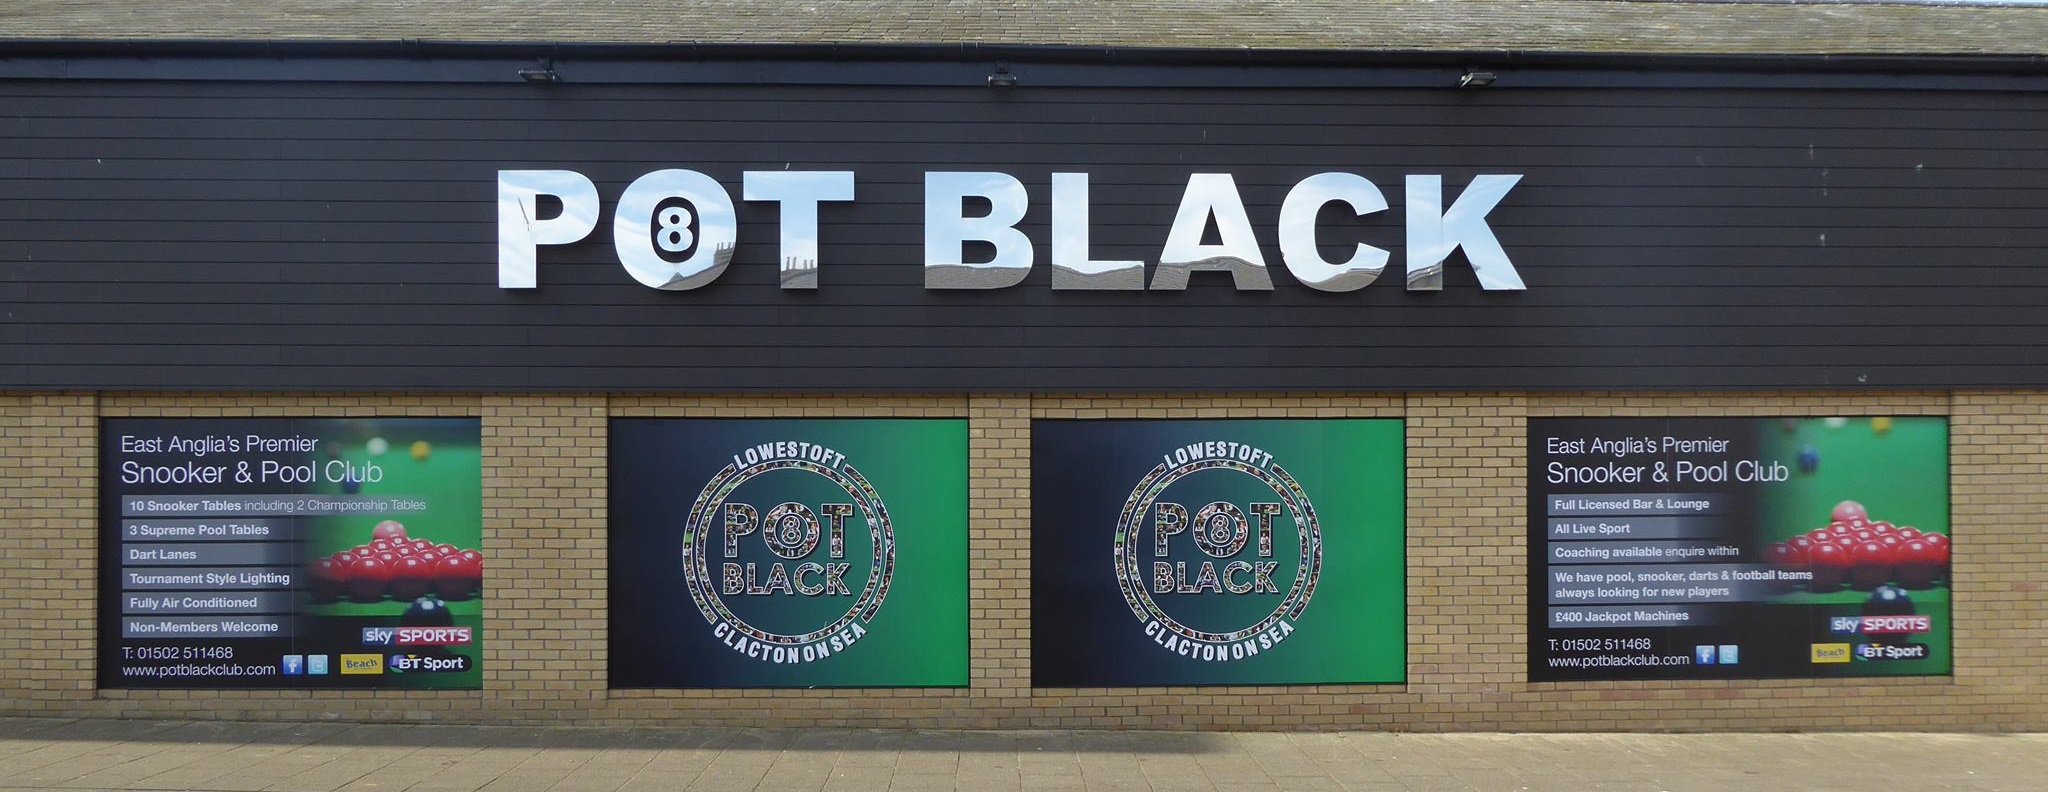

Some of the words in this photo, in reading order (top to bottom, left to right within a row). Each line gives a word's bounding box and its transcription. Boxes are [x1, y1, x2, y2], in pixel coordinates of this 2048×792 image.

[497, 169, 855, 290] POT
[924, 172, 1527, 291] BLACK
[121, 435, 163, 453] East
[246, 436, 318, 452] Premier
[1547, 438, 1585, 454] East
[1662, 437, 1729, 453] Premier
[733, 441, 846, 469] LOWESTOFT
[1164, 440, 1273, 469] LOWESTOFT
[121, 462, 227, 485] Snooker
[235, 462, 253, 483] &
[261, 461, 316, 483] Pool
[325, 460, 383, 483] Club
[1547, 463, 1645, 484] Snooker
[1652, 462, 1669, 482] &
[1676, 462, 1728, 482] Pool
[1736, 460, 1788, 482] Club
[130, 501, 144, 511] 10
[147, 501, 200, 511] Snooker
[202, 500, 241, 511] Tables
[244, 499, 294, 512] including
[297, 500, 304, 511] 2
[308, 499, 388, 512] Championship
[390, 500, 426, 510] Tables
[1555, 500, 1575, 510] Full
[1578, 499, 1630, 510] Licensed
[1634, 499, 1653, 509] Bar
[1656, 499, 1664, 509] &
[1667, 499, 1710, 512] Lounge
[130, 525, 137, 535] 3
[140, 525, 196, 538] Supreme
[199, 525, 227, 535] Pool
[229, 524, 269, 535] Tables
[724, 502, 853, 559] POT
[1155, 501, 1281, 558] POT
[1555, 524, 1568, 533] All
[1572, 524, 1595, 533] Live
[1599, 523, 1630, 536] Sport
[130, 549, 156, 560] Dart
[160, 549, 197, 560] Lanes
[1555, 547, 1609, 560] Coaching
[1612, 546, 1662, 557] available
[1665, 547, 1705, 559] enquire
[1708, 546, 1739, 556] within
[130, 573, 204, 584] Tournament
[207, 573, 237, 586] Style
[240, 572, 290, 586] Lighting
[723, 562, 850, 595] BLACK
[1154, 561, 1279, 594] BLACK
[1555, 572, 1572, 582] We
[1575, 572, 1604, 582] have
[1606, 572, 1635, 584] pool,
[1638, 571, 1686, 584] snooker,
[1688, 570, 1718, 581] darts
[1720, 570, 1729, 580] &
[1732, 570, 1775, 580] football
[1778, 570, 1813, 580] teams
[1555, 587, 1595, 600] always
[1598, 587, 1640, 600] looking
[1642, 586, 1658, 597] for
[1661, 587, 1685, 597] new
[1688, 586, 1729, 598] players
[130, 598, 160, 611] Fully
[162, 598, 180, 608] Air
[183, 597, 258, 608] Conditioned
[1555, 611, 1582, 622] £400
[1585, 611, 1631, 624] Jackpot
[1634, 610, 1689, 621] Machines
[130, 621, 218, 632] Non-Members
[220, 621, 278, 632] Welcome
[1834, 617, 1858, 632] sky
[1864, 617, 1928, 631] SPORTS
[366, 628, 393, 644] sky
[399, 629, 469, 642] SPORTS
[713, 622, 799, 664] CLACTON
[803, 641, 830, 662] ON
[829, 622, 868, 652] SEA
[1144, 620, 1228, 661] CLACTON
[1232, 639, 1259, 660] ON
[1258, 620, 1296, 650] SEA
[1548, 640, 1559, 651] T:
[1562, 639, 1601, 651] 01502
[1604, 639, 1651, 651] 511468
[1864, 645, 1883, 658] BT
[1885, 645, 1922, 658] Sport
[123, 647, 134, 659] T:
[137, 647, 179, 659] 01502
[183, 647, 233, 659] 511468
[1816, 648, 1845, 658] Beach
[345, 658, 377, 670] Beach
[399, 658, 421, 669] BT
[423, 657, 464, 671] Sport
[1548, 653, 1690, 668] www.potblackclub.com
[122, 663, 276, 678] www.potblackclub.com
